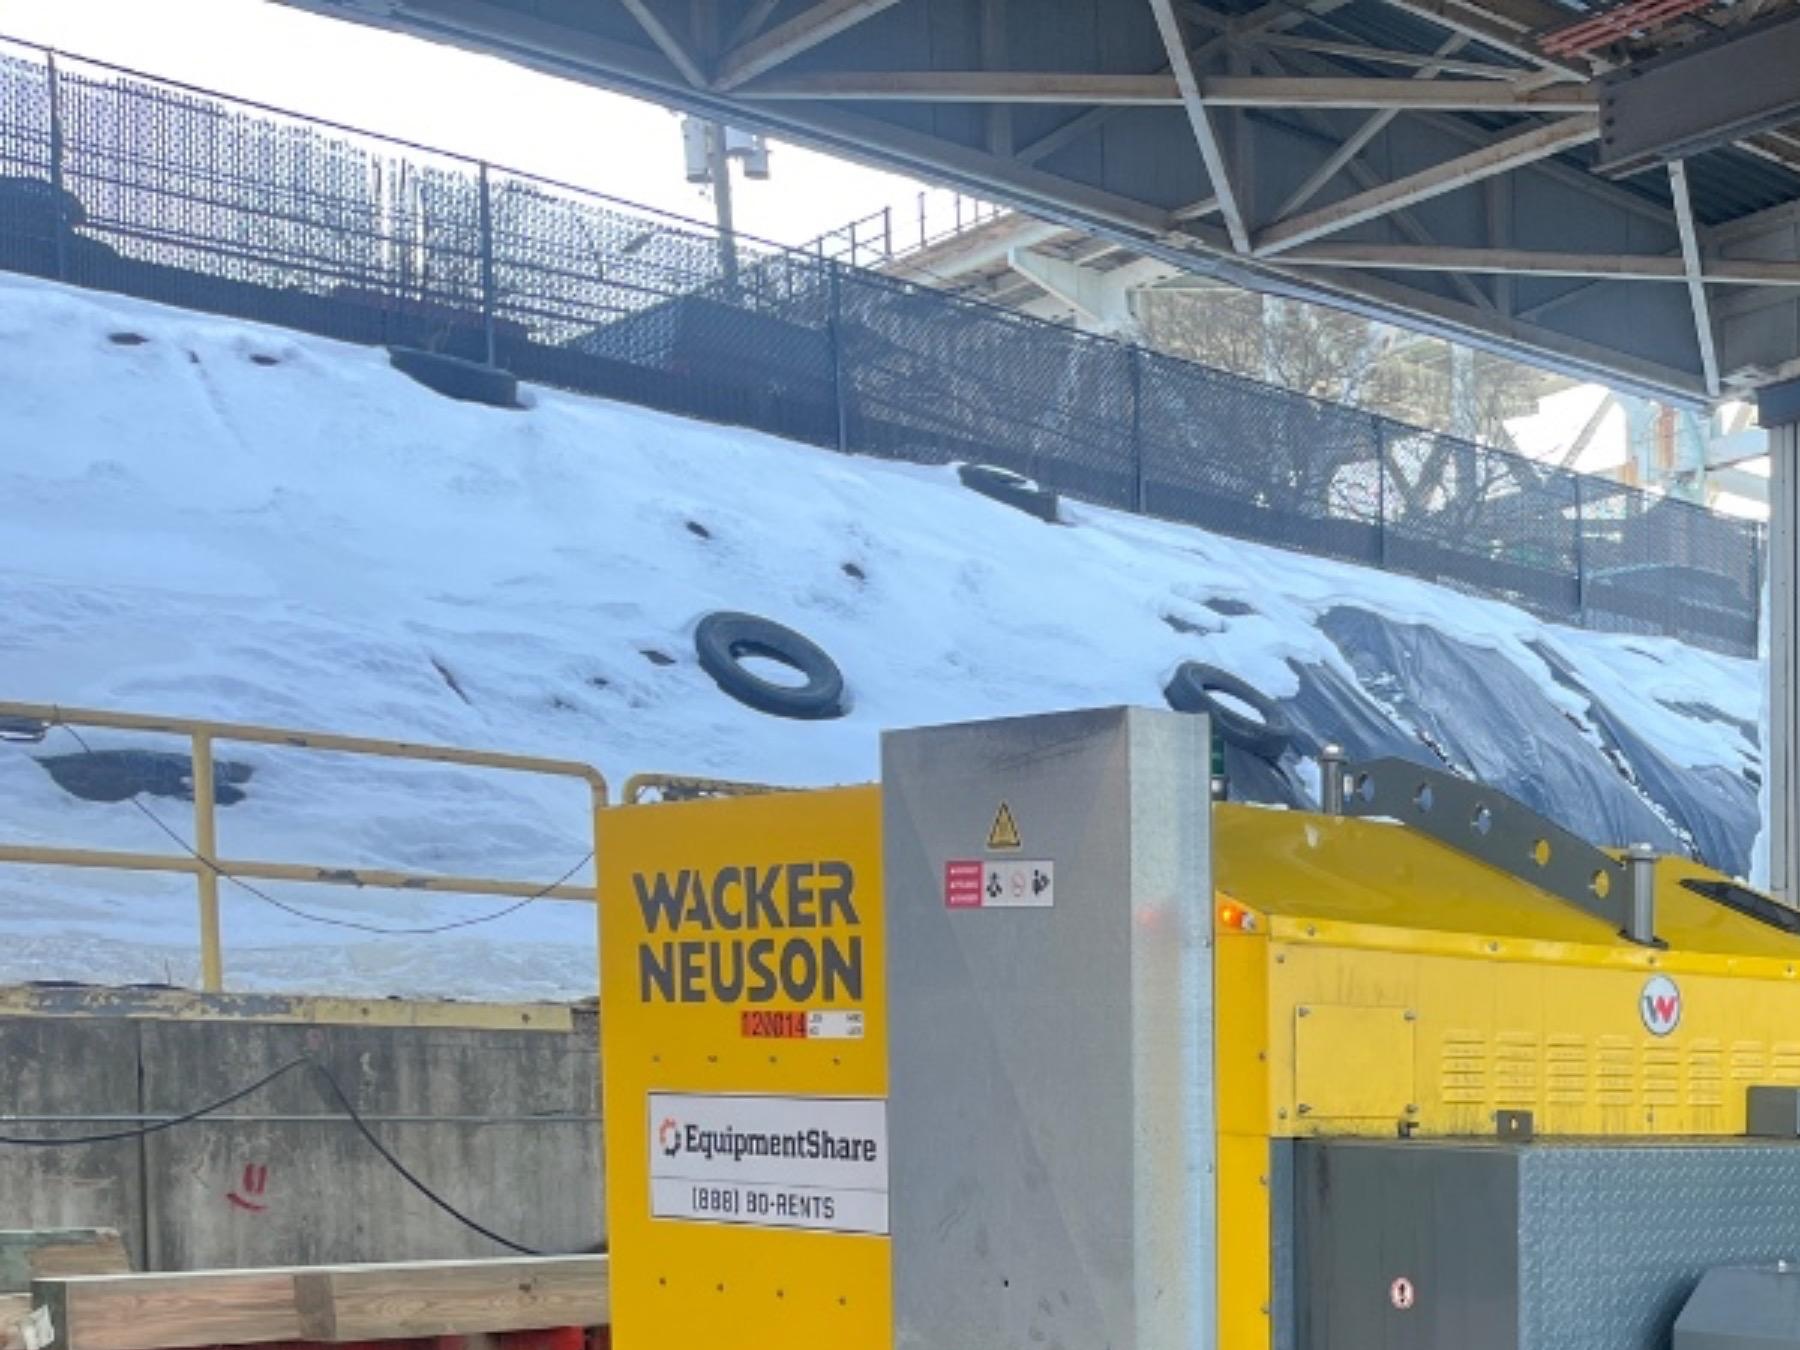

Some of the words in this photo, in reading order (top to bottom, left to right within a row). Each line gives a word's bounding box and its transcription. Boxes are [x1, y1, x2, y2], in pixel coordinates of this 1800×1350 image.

[632, 860, 860, 933] WACKER
[638, 935, 862, 1003] NEUSON
[684, 1123, 877, 1162] EquipmentShare
[692, 1185, 739, 1215] (888)
